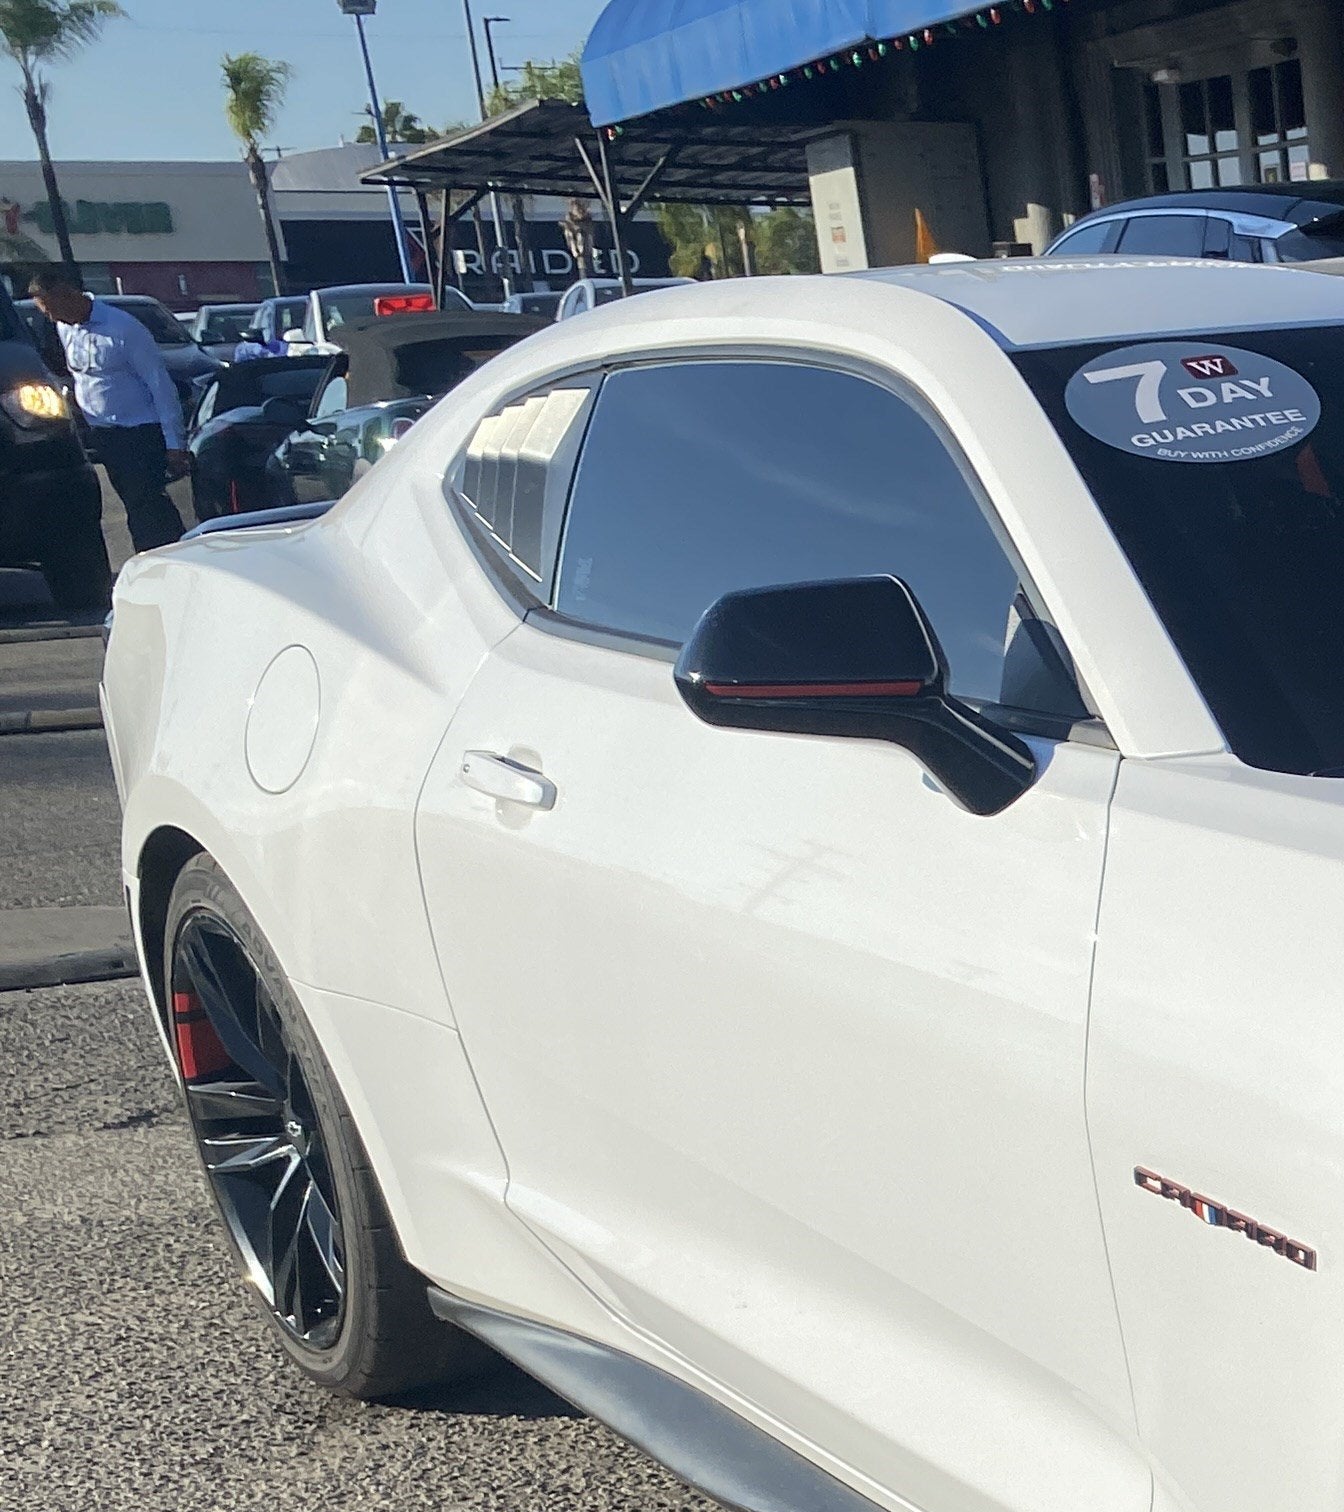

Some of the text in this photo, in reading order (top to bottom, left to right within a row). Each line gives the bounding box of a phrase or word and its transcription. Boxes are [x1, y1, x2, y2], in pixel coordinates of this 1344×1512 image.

[1083, 360, 1274, 424] 7 DAY
[1131, 408, 1306, 447] GUARANTEE
[1157, 425, 1304, 459] BUY WITH CONFIDENCE
